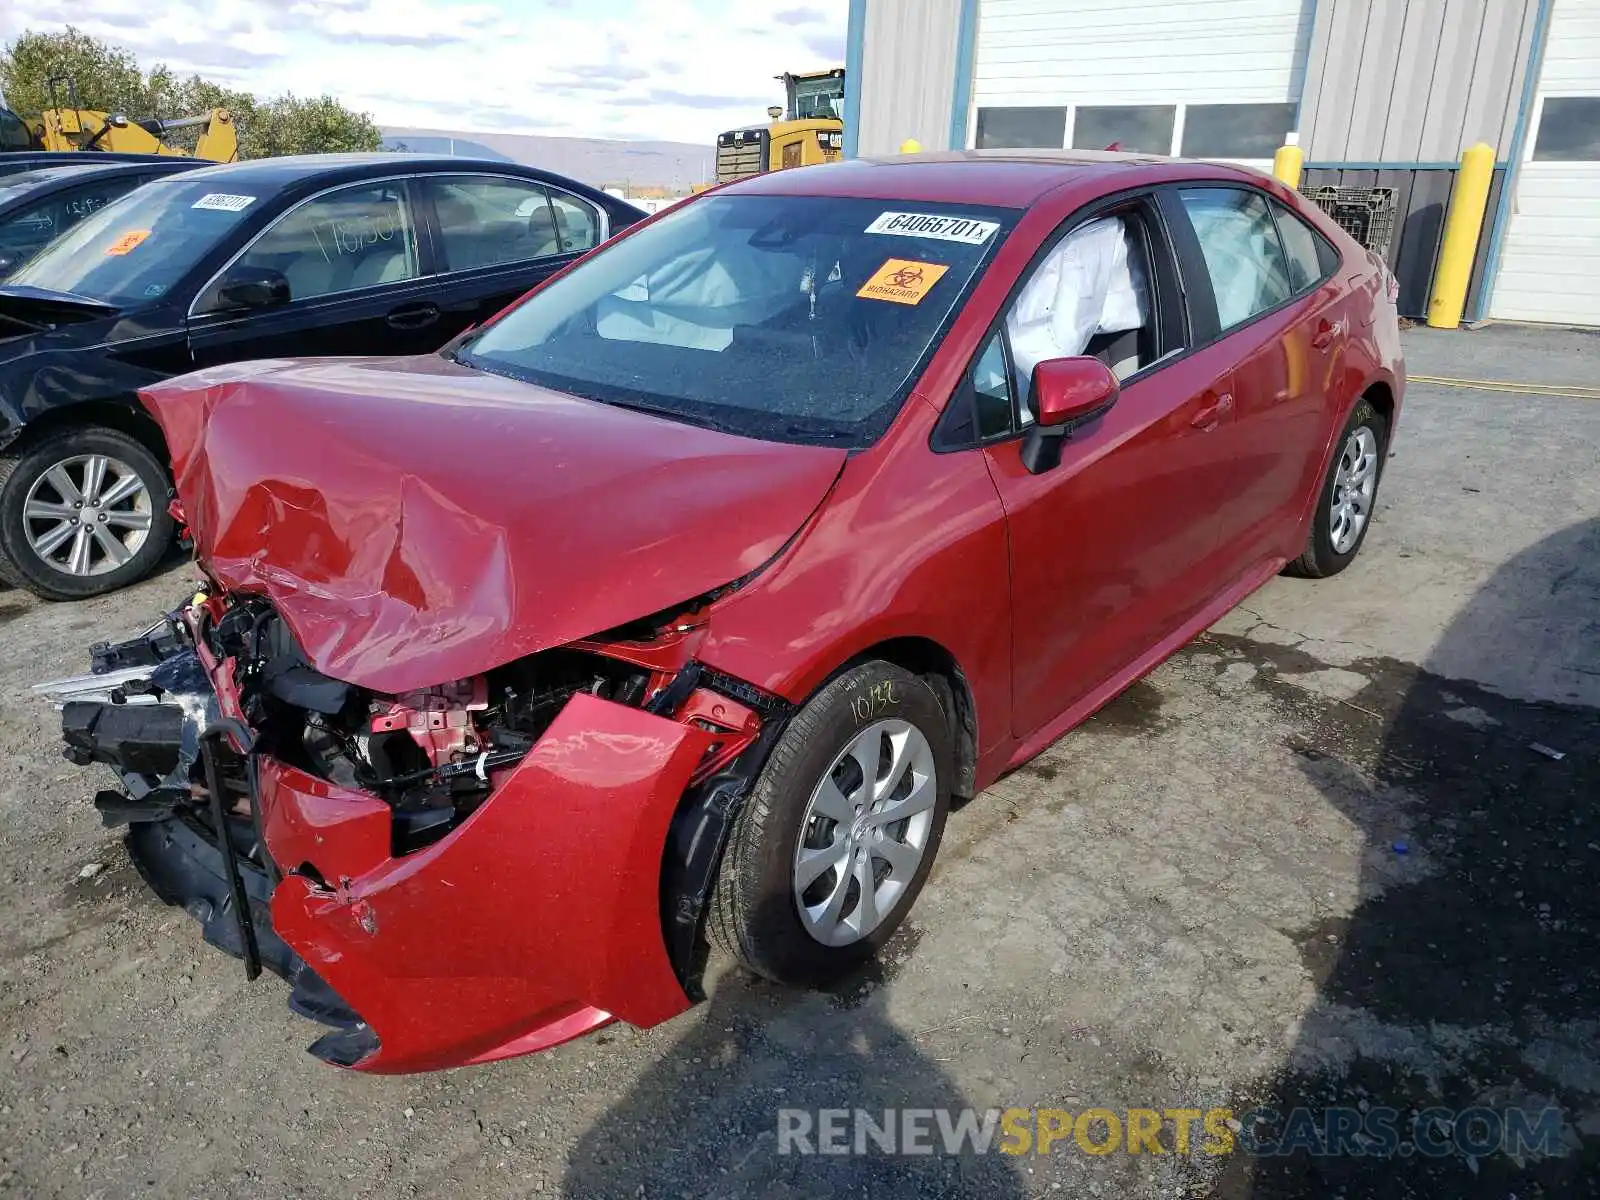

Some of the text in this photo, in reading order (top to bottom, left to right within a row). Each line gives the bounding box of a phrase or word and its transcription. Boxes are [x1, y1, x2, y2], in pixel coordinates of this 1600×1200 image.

[829, 133, 842, 148] CAT
[887, 214, 981, 237] 64066701
[867, 285, 920, 299] BIOHAZARD
